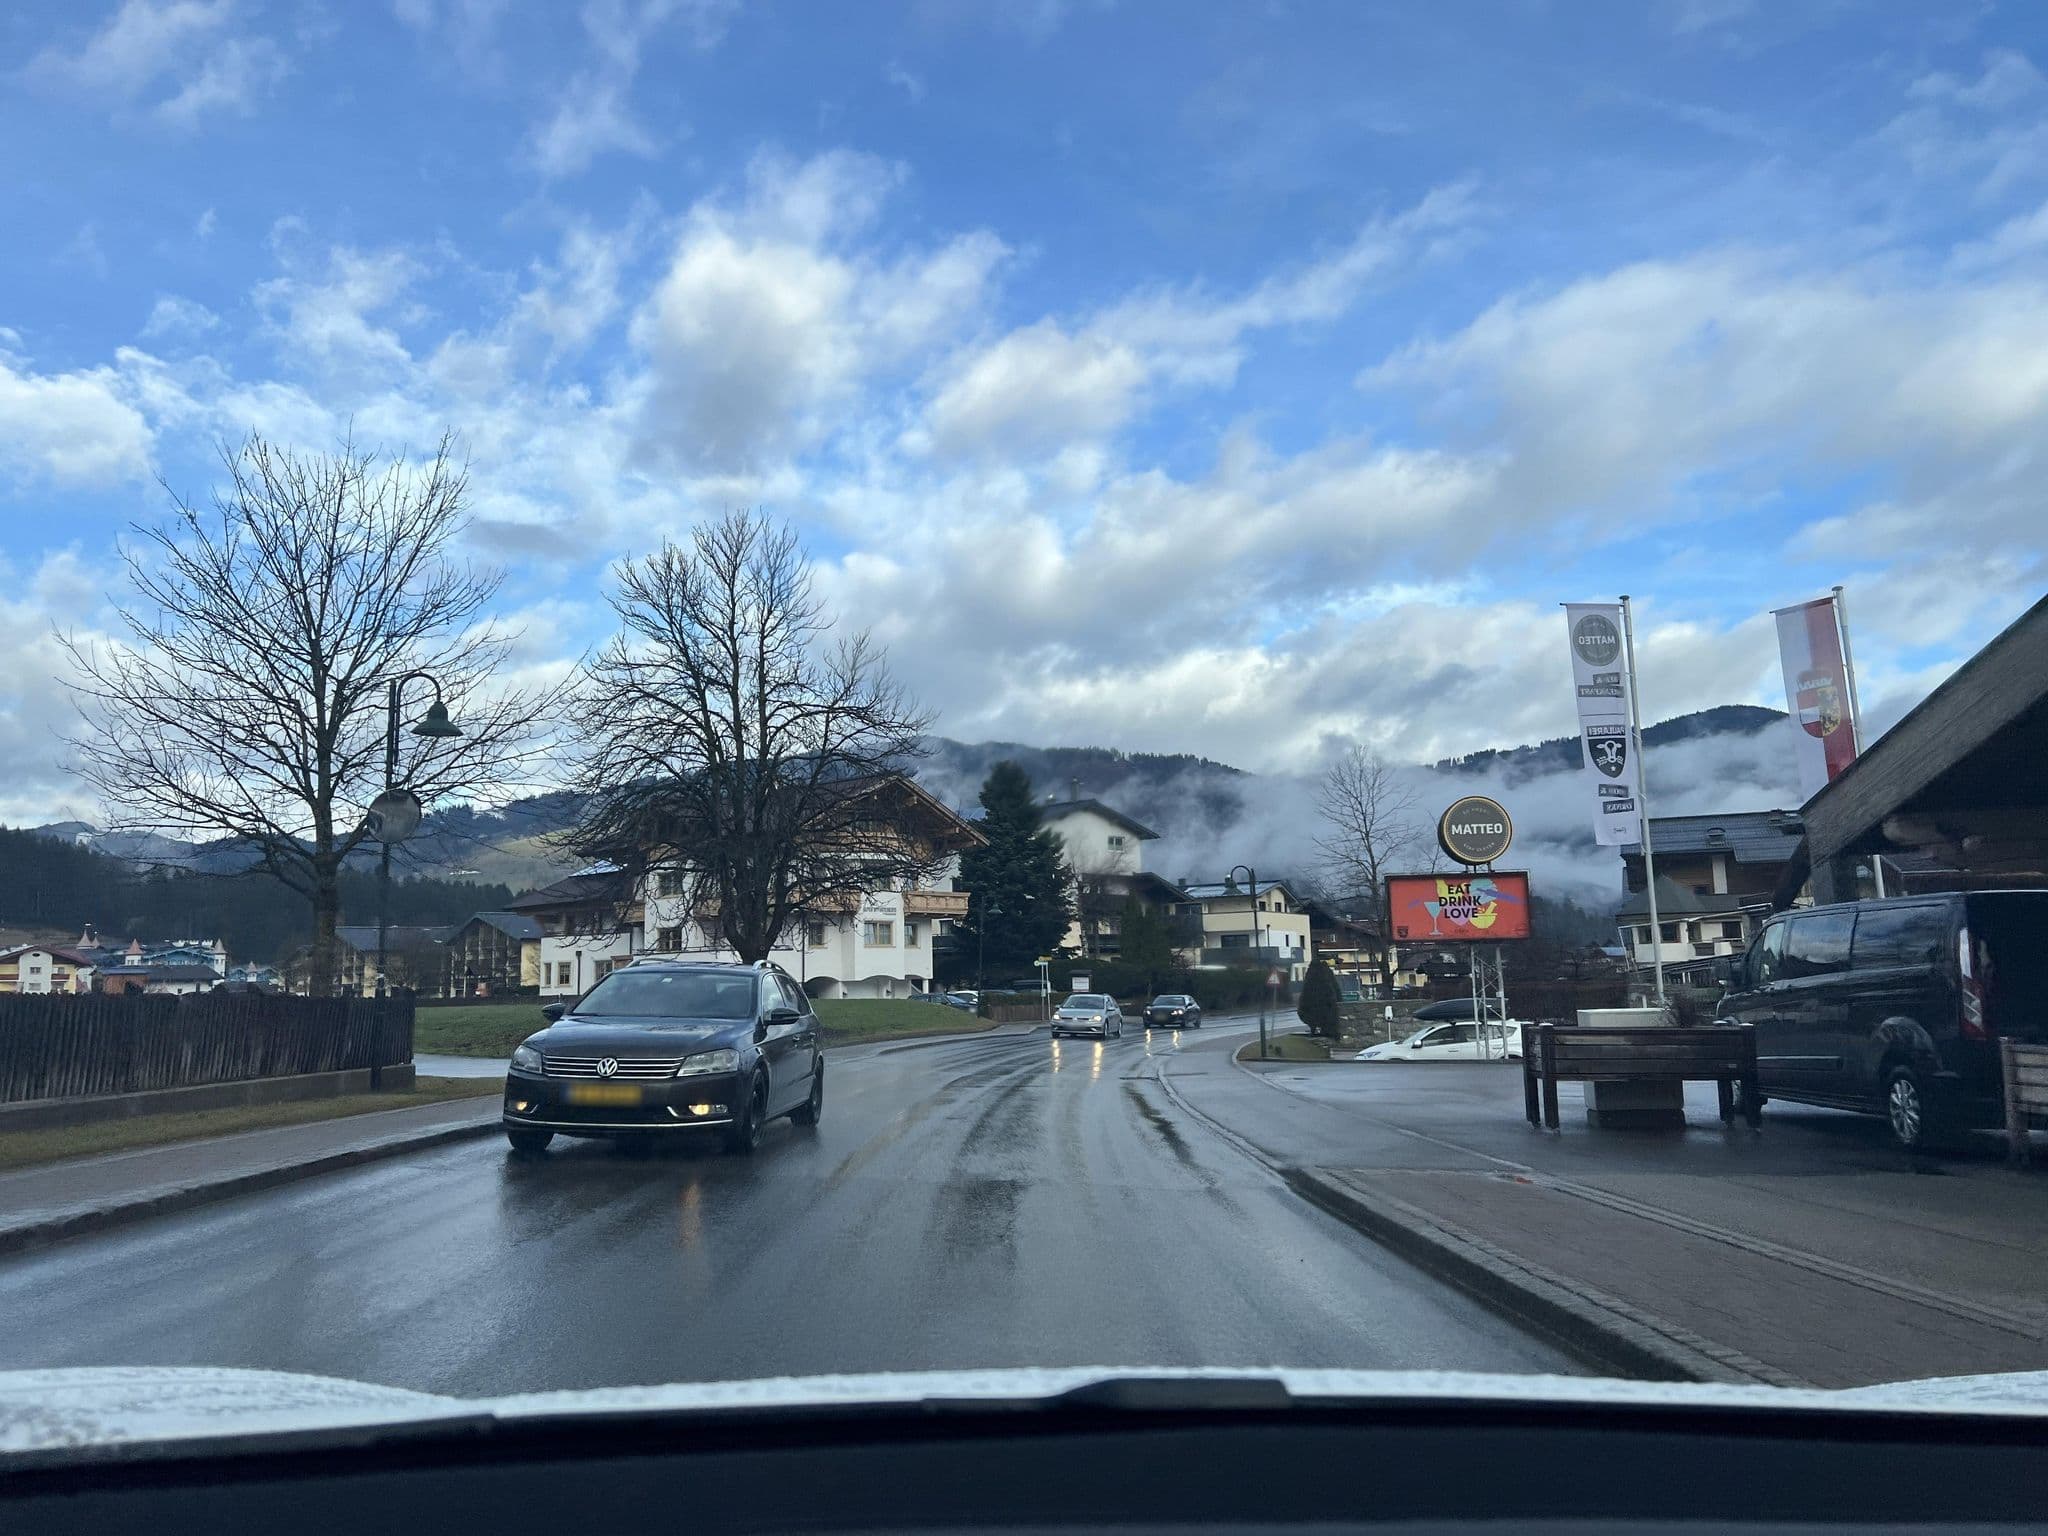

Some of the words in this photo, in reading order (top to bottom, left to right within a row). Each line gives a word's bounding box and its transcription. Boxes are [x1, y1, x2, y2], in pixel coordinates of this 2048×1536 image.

[1451, 823, 1503, 835] MATTEO
[1447, 884, 1471, 895] EAT
[1438, 895, 1482, 907] DRINK
[1444, 908, 1479, 919] LOVE
